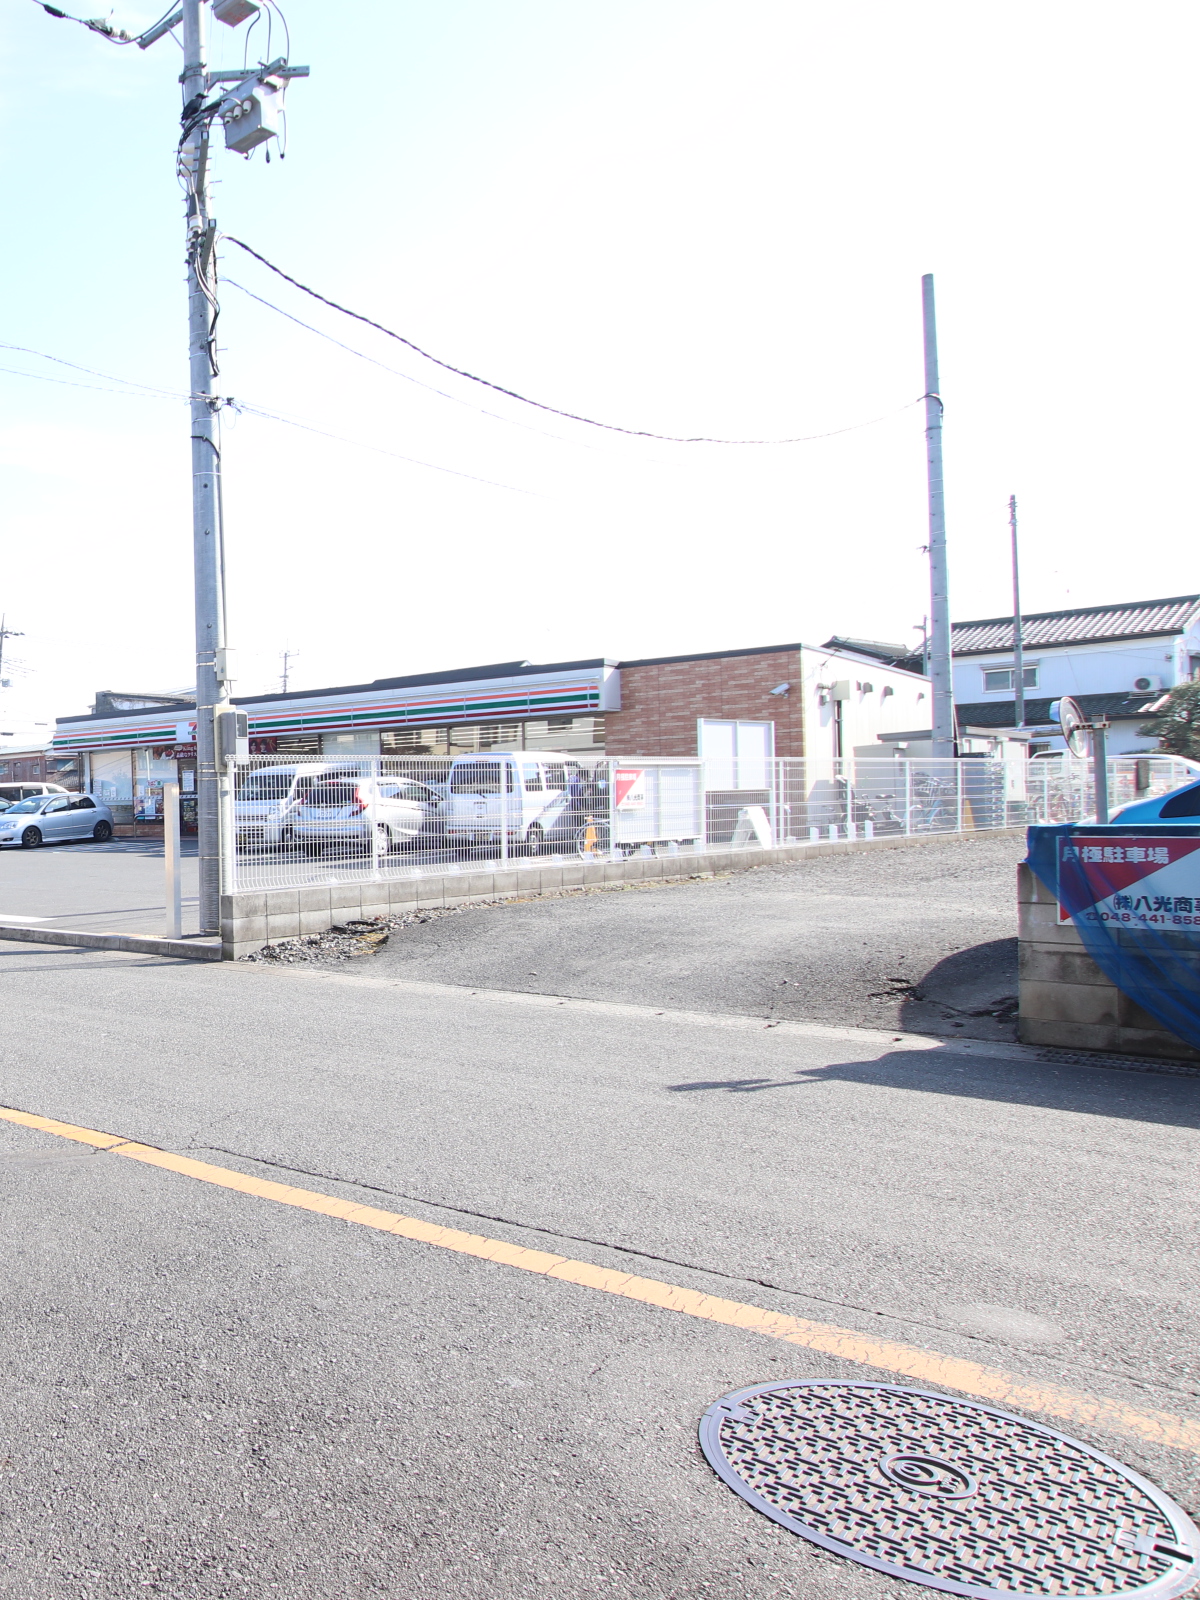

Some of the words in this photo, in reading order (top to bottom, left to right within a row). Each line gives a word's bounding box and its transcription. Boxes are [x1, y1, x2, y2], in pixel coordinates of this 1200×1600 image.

[1062, 846, 1170, 865] 月極駐車場
